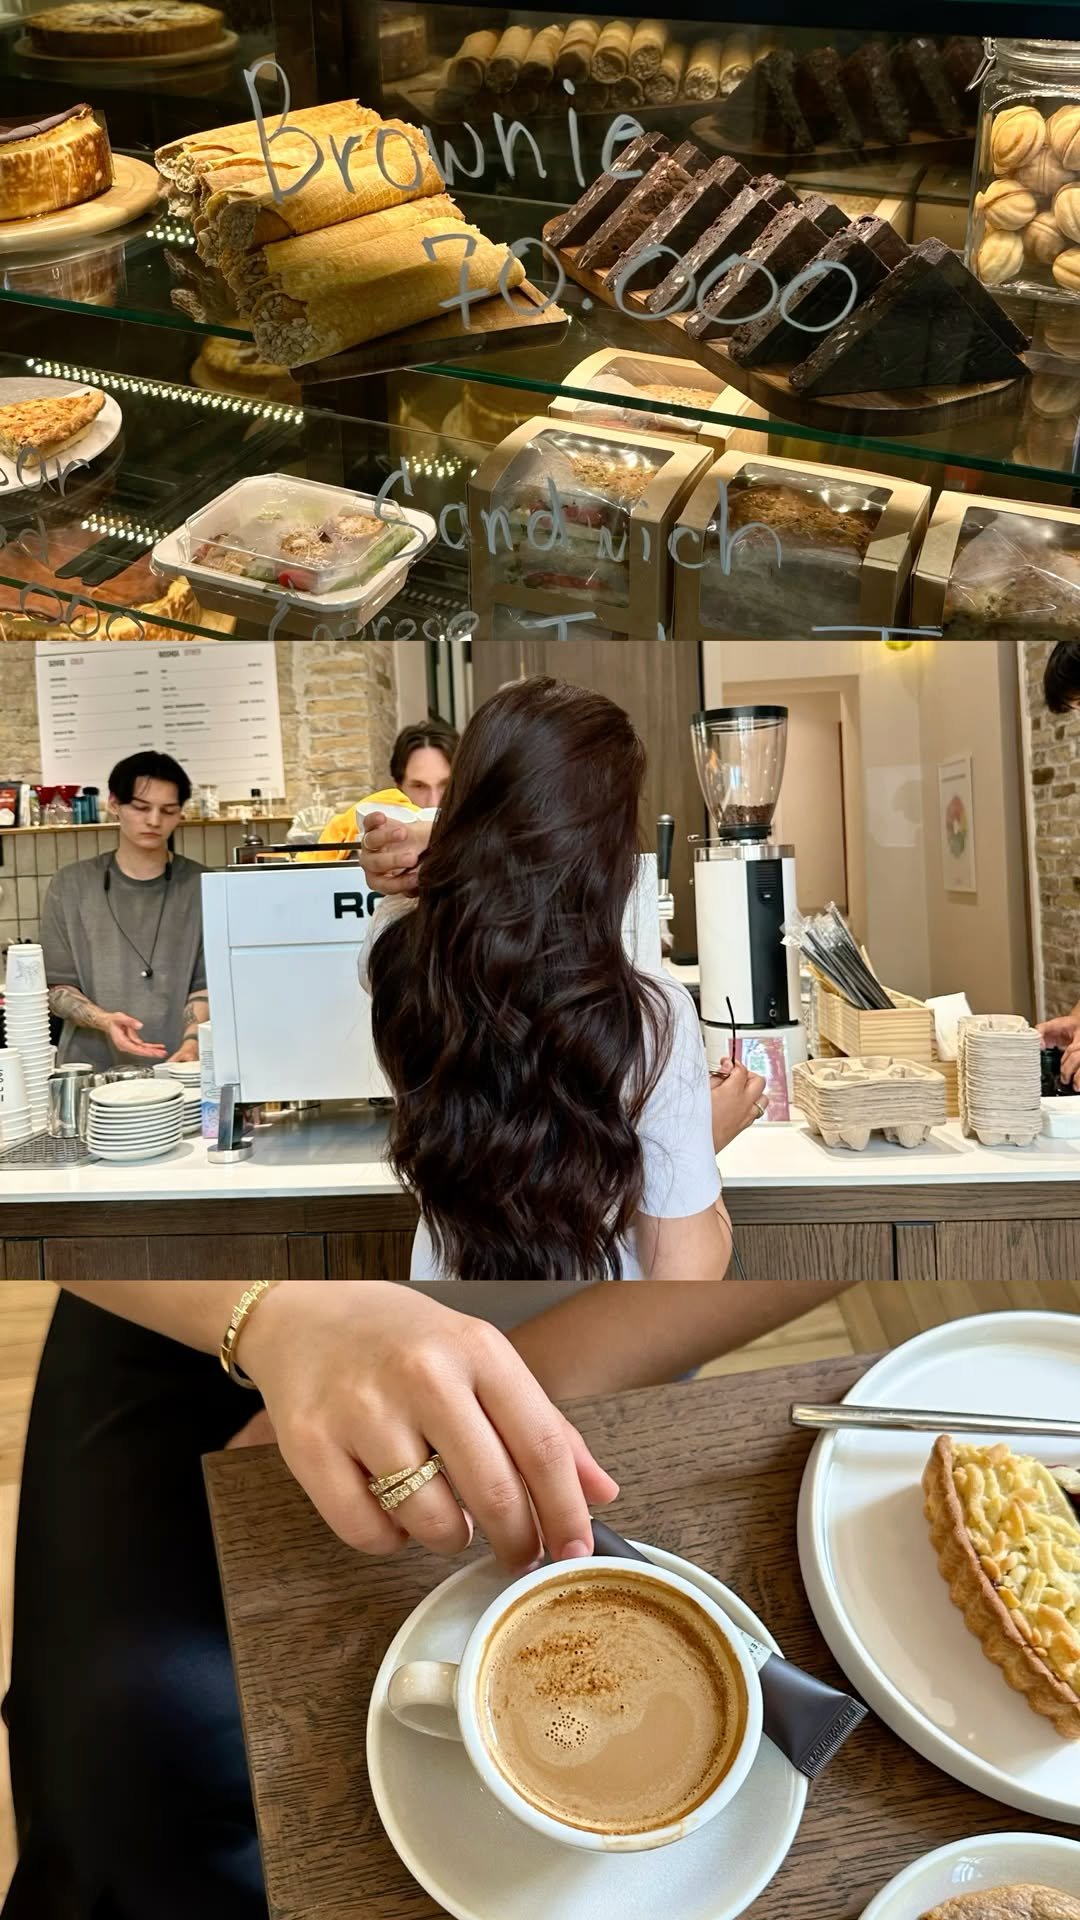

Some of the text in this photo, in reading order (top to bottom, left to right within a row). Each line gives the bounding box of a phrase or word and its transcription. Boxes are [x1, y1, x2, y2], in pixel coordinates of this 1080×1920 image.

[244, 60, 646, 204] Brownie
[420, 233, 859, 333] 70.000
[374, 456, 782, 576] Sandwich
